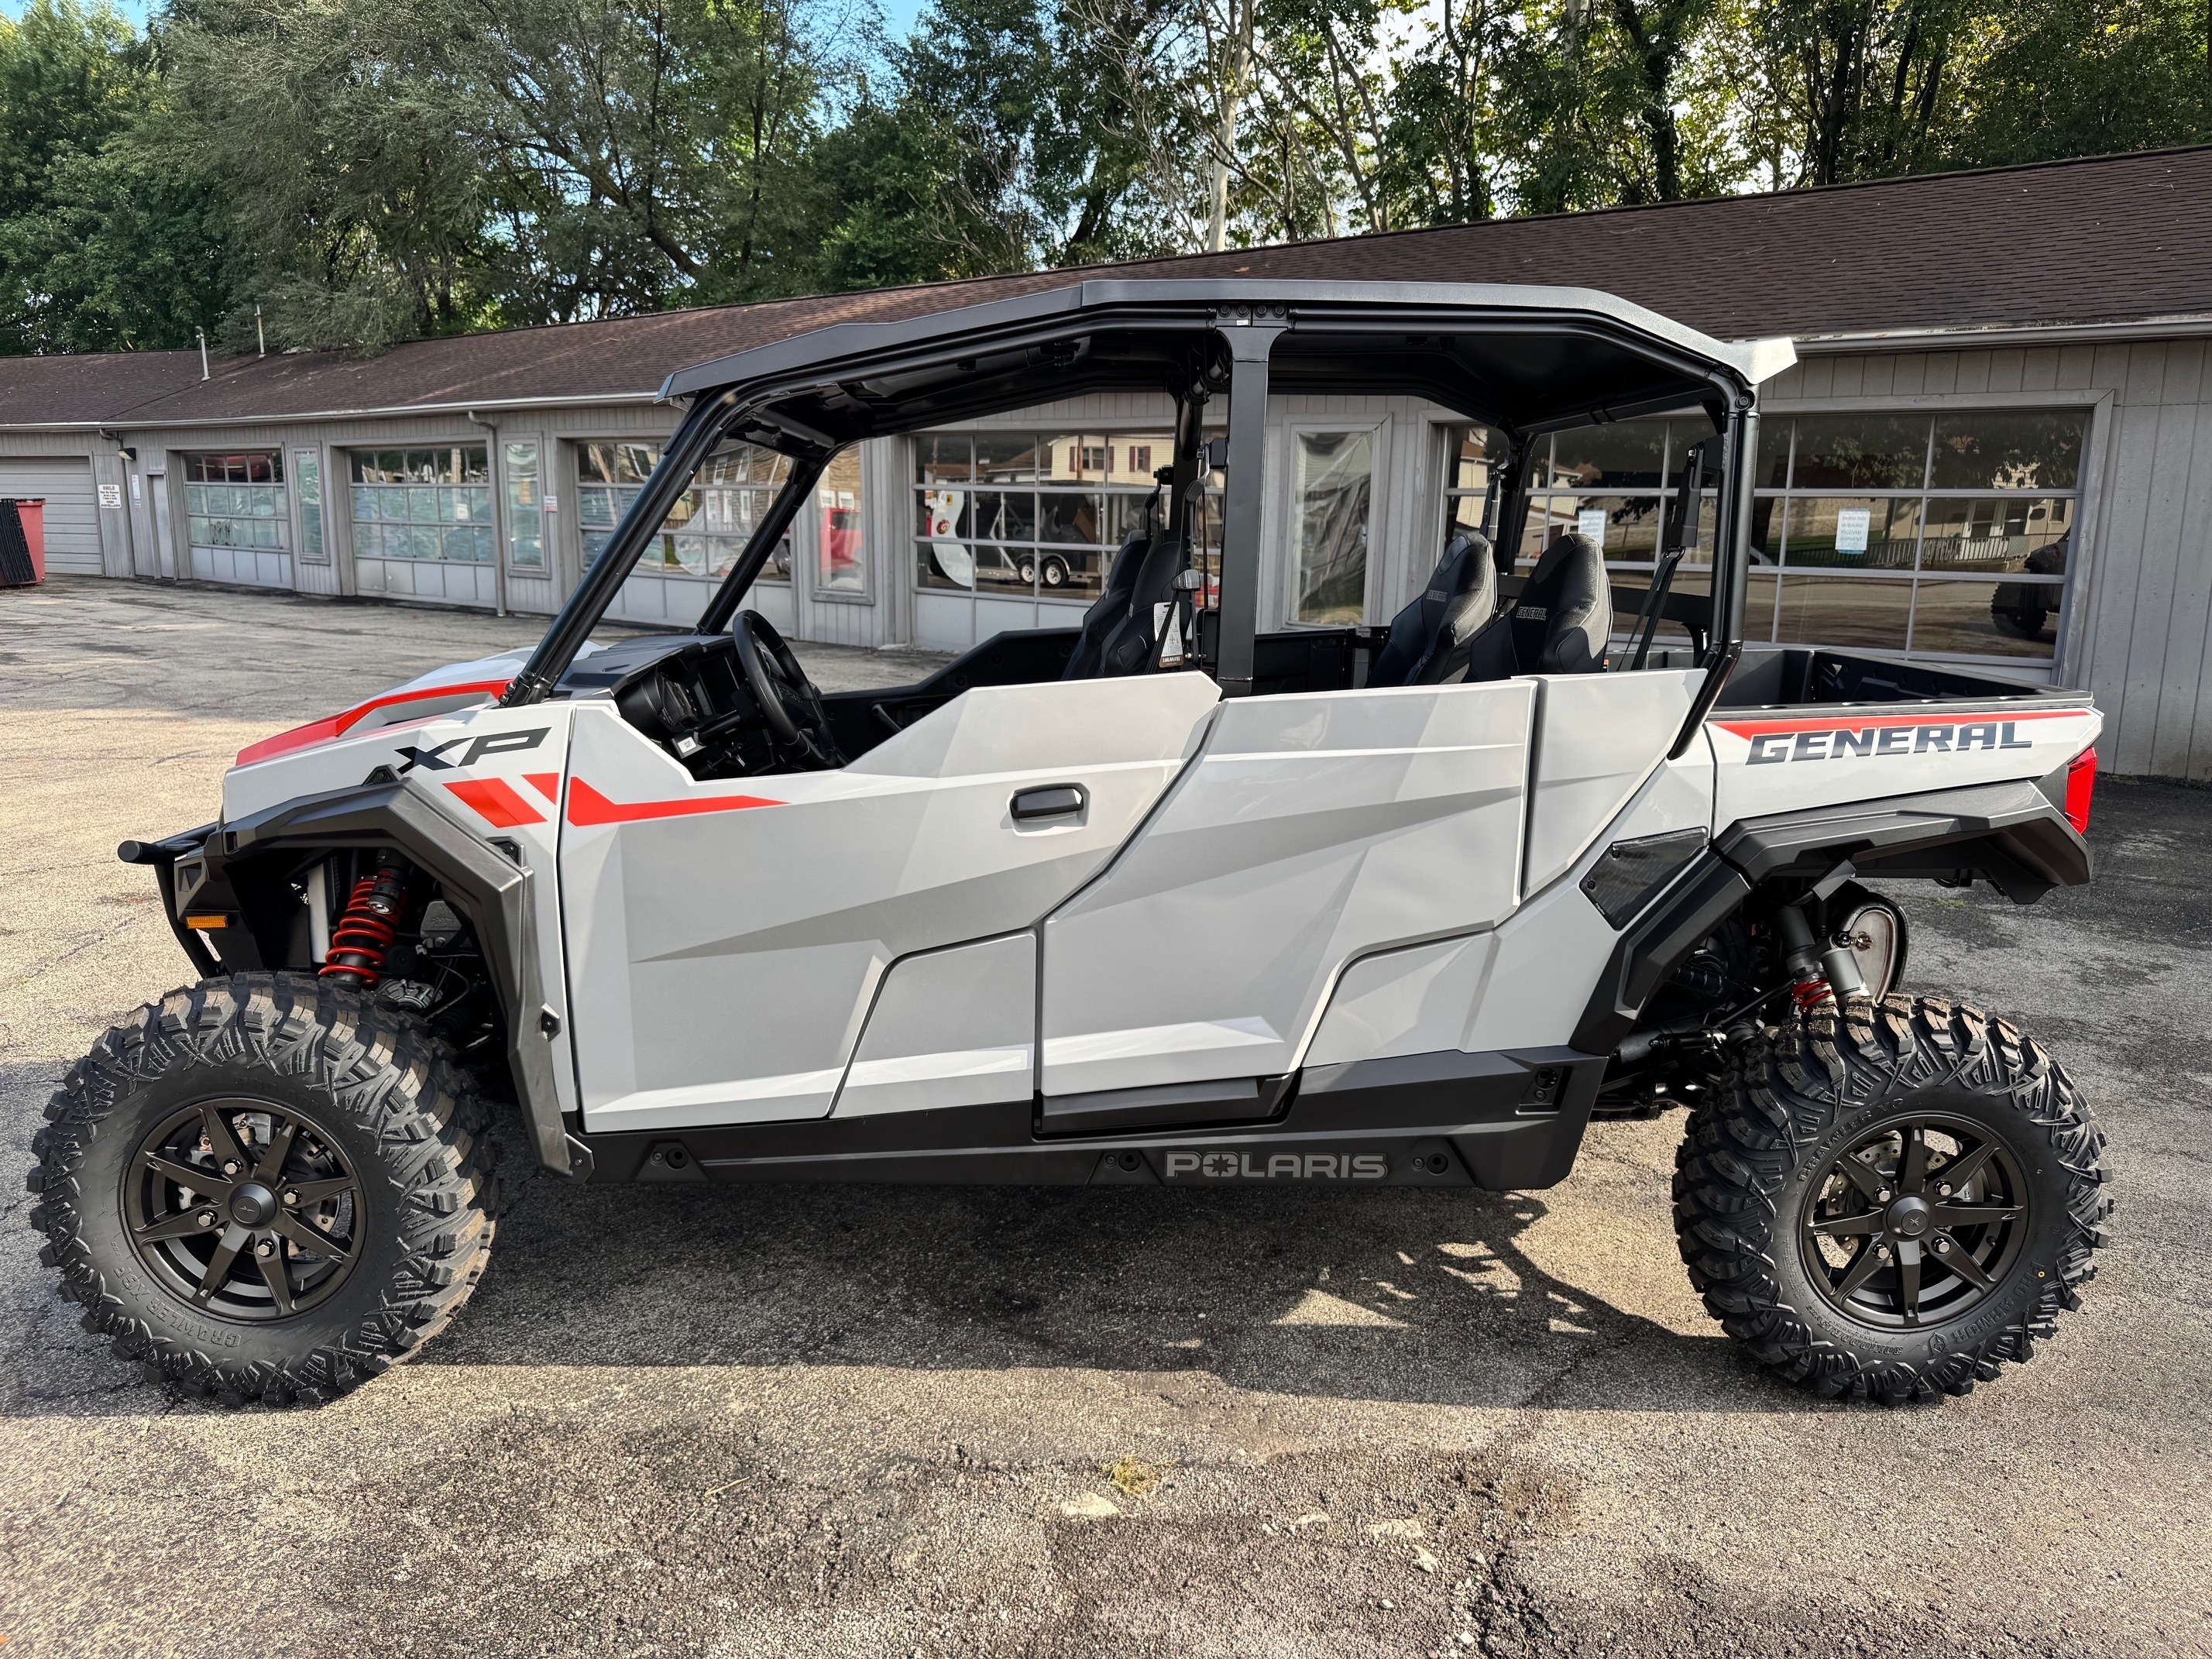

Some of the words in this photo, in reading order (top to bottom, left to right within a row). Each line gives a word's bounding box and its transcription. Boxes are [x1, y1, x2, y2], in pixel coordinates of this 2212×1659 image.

[1427, 589, 1448, 603] GENERAL
[1516, 606, 1547, 620] GENERAL
[394, 726, 552, 775] XP
[1745, 722, 2032, 765] GENERAL
[1165, 1152, 1386, 1179] POLARIS
[2014, 1261, 2045, 1297] PRO
[1951, 1296, 2014, 1343] ARMOR
